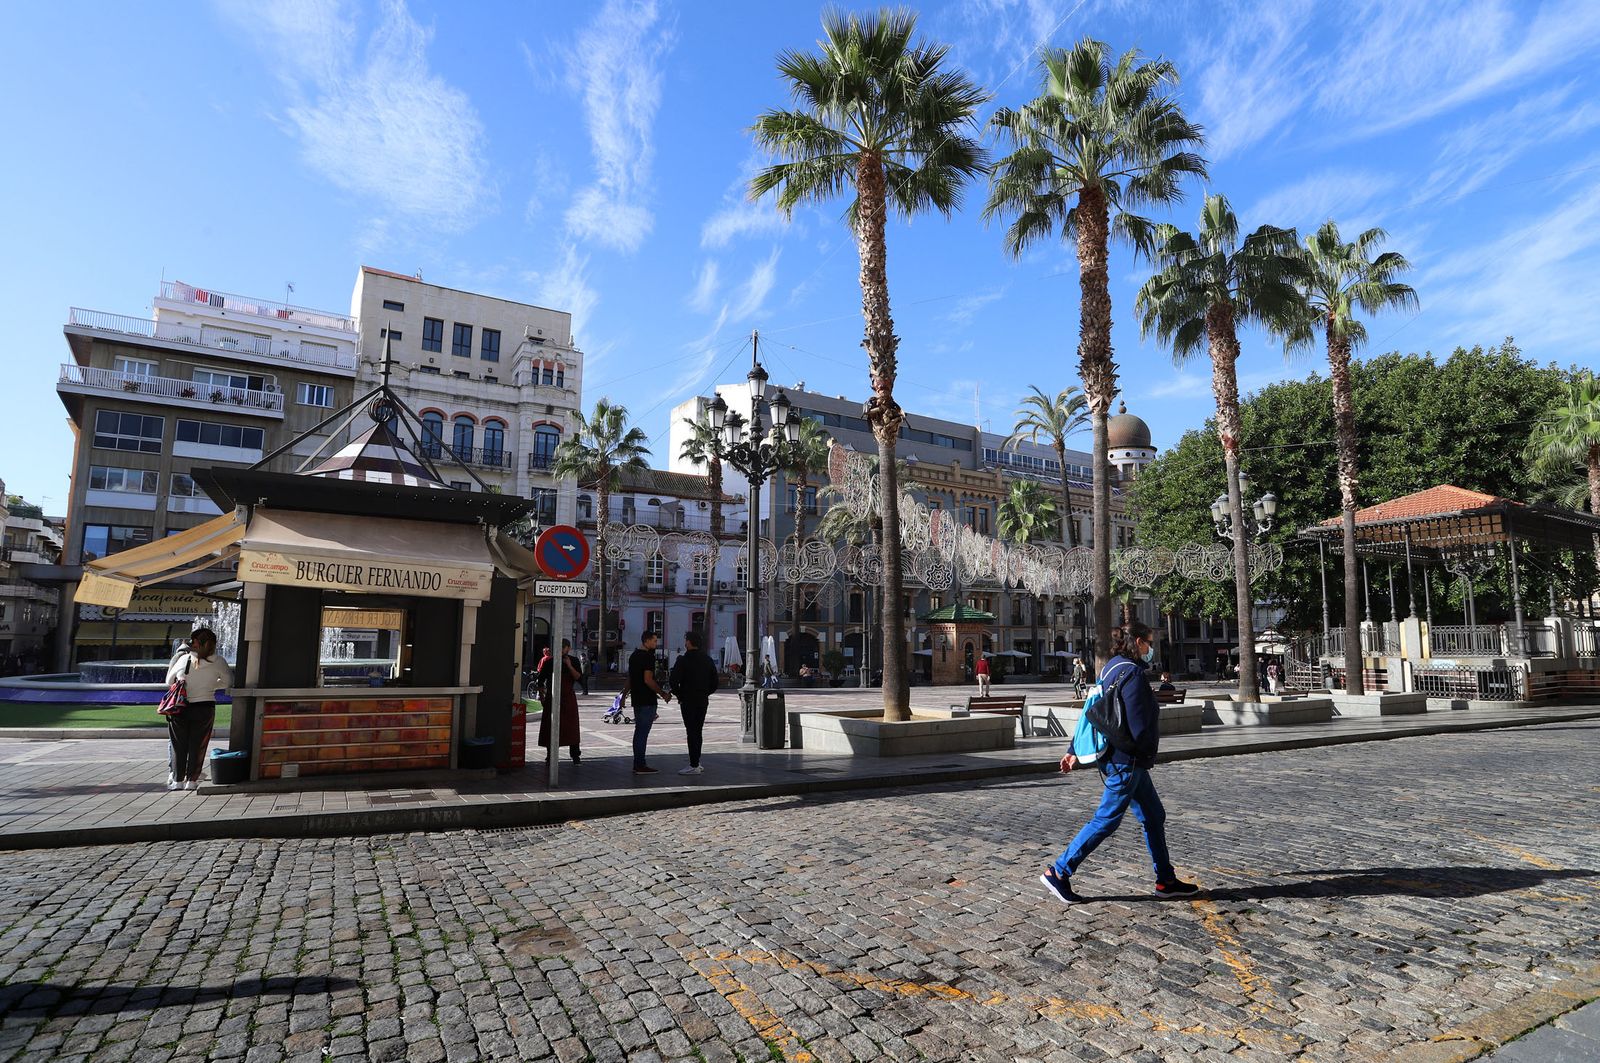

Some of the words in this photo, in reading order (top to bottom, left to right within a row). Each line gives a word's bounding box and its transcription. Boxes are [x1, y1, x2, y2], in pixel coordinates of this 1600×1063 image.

[251, 560, 289, 571] Cruzcampo
[295, 560, 363, 586] BURGUER
[367, 566, 442, 591] FERNANDO
[538, 584, 567, 594] EXCEPTO
[568, 585, 585, 595] TAXIS
